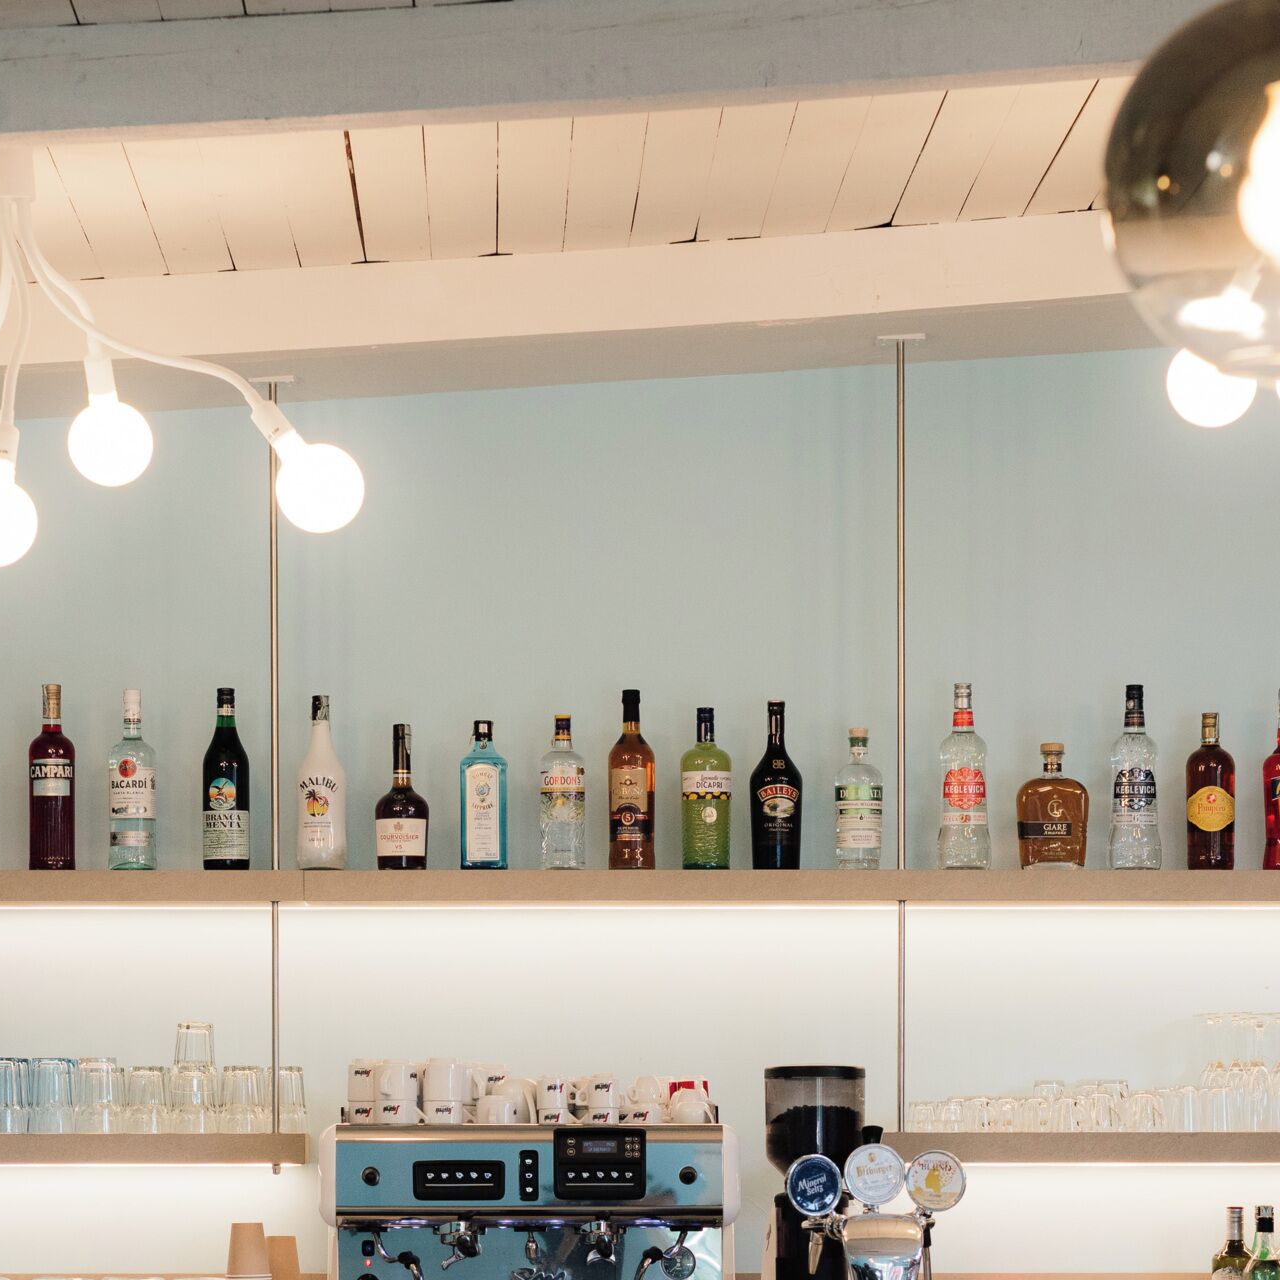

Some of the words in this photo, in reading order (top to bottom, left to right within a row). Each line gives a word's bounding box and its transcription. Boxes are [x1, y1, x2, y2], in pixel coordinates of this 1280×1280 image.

[31, 766, 73, 778] CAMPARI
[111, 778, 147, 789] BACARDÍ
[299, 776, 339, 793] MALIBU
[761, 786, 797, 798] BAILEYS
[945, 785, 984, 793] KEGLEVICH
[1115, 785, 1155, 794] KEGLEVICH
[205, 813, 241, 822] BRANCA
[624, 814, 631, 822] 5
[1043, 823, 1068, 831] GIARE
[797, 1173, 827, 1192] Mineral
